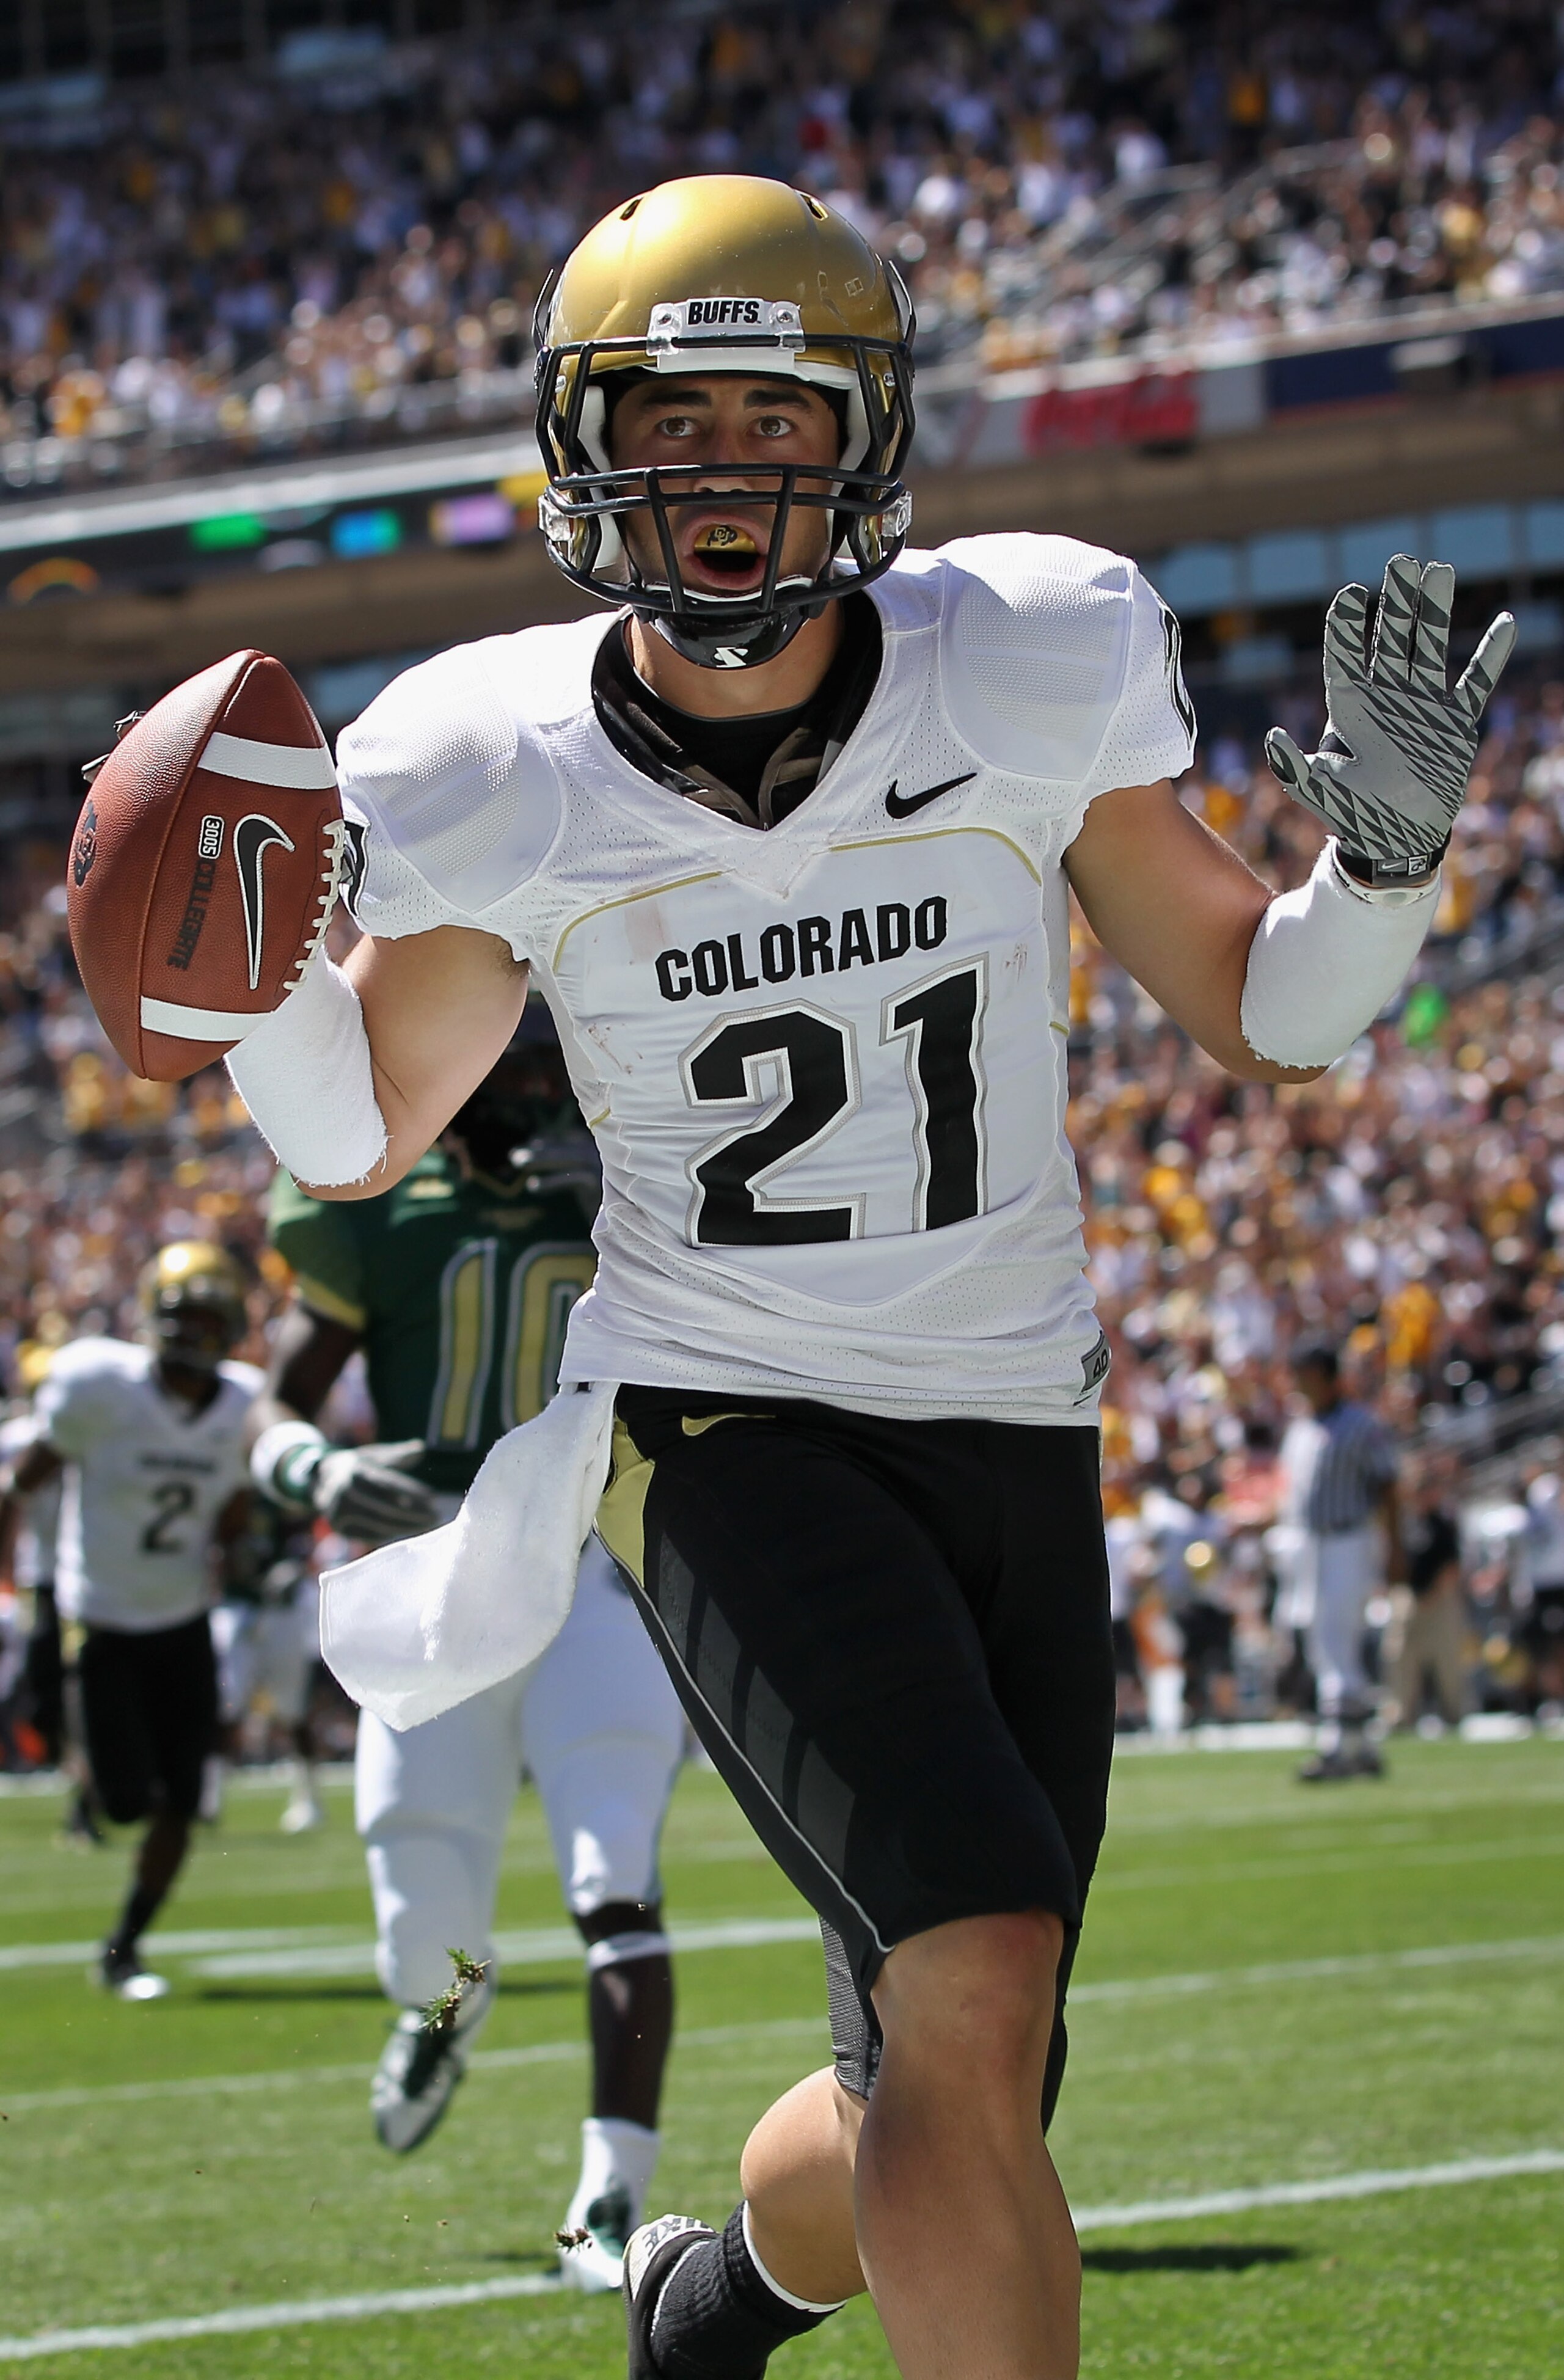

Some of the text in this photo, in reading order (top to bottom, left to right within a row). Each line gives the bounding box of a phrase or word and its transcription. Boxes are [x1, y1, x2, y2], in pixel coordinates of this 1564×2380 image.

[688, 301, 760, 326] BUFFS
[202, 819, 220, 855] 3005
[166, 859, 216, 970] COLLEGIATE
[655, 896, 948, 1002] COLORADO
[678, 951, 990, 1249] 21
[145, 1480, 197, 1554] 2
